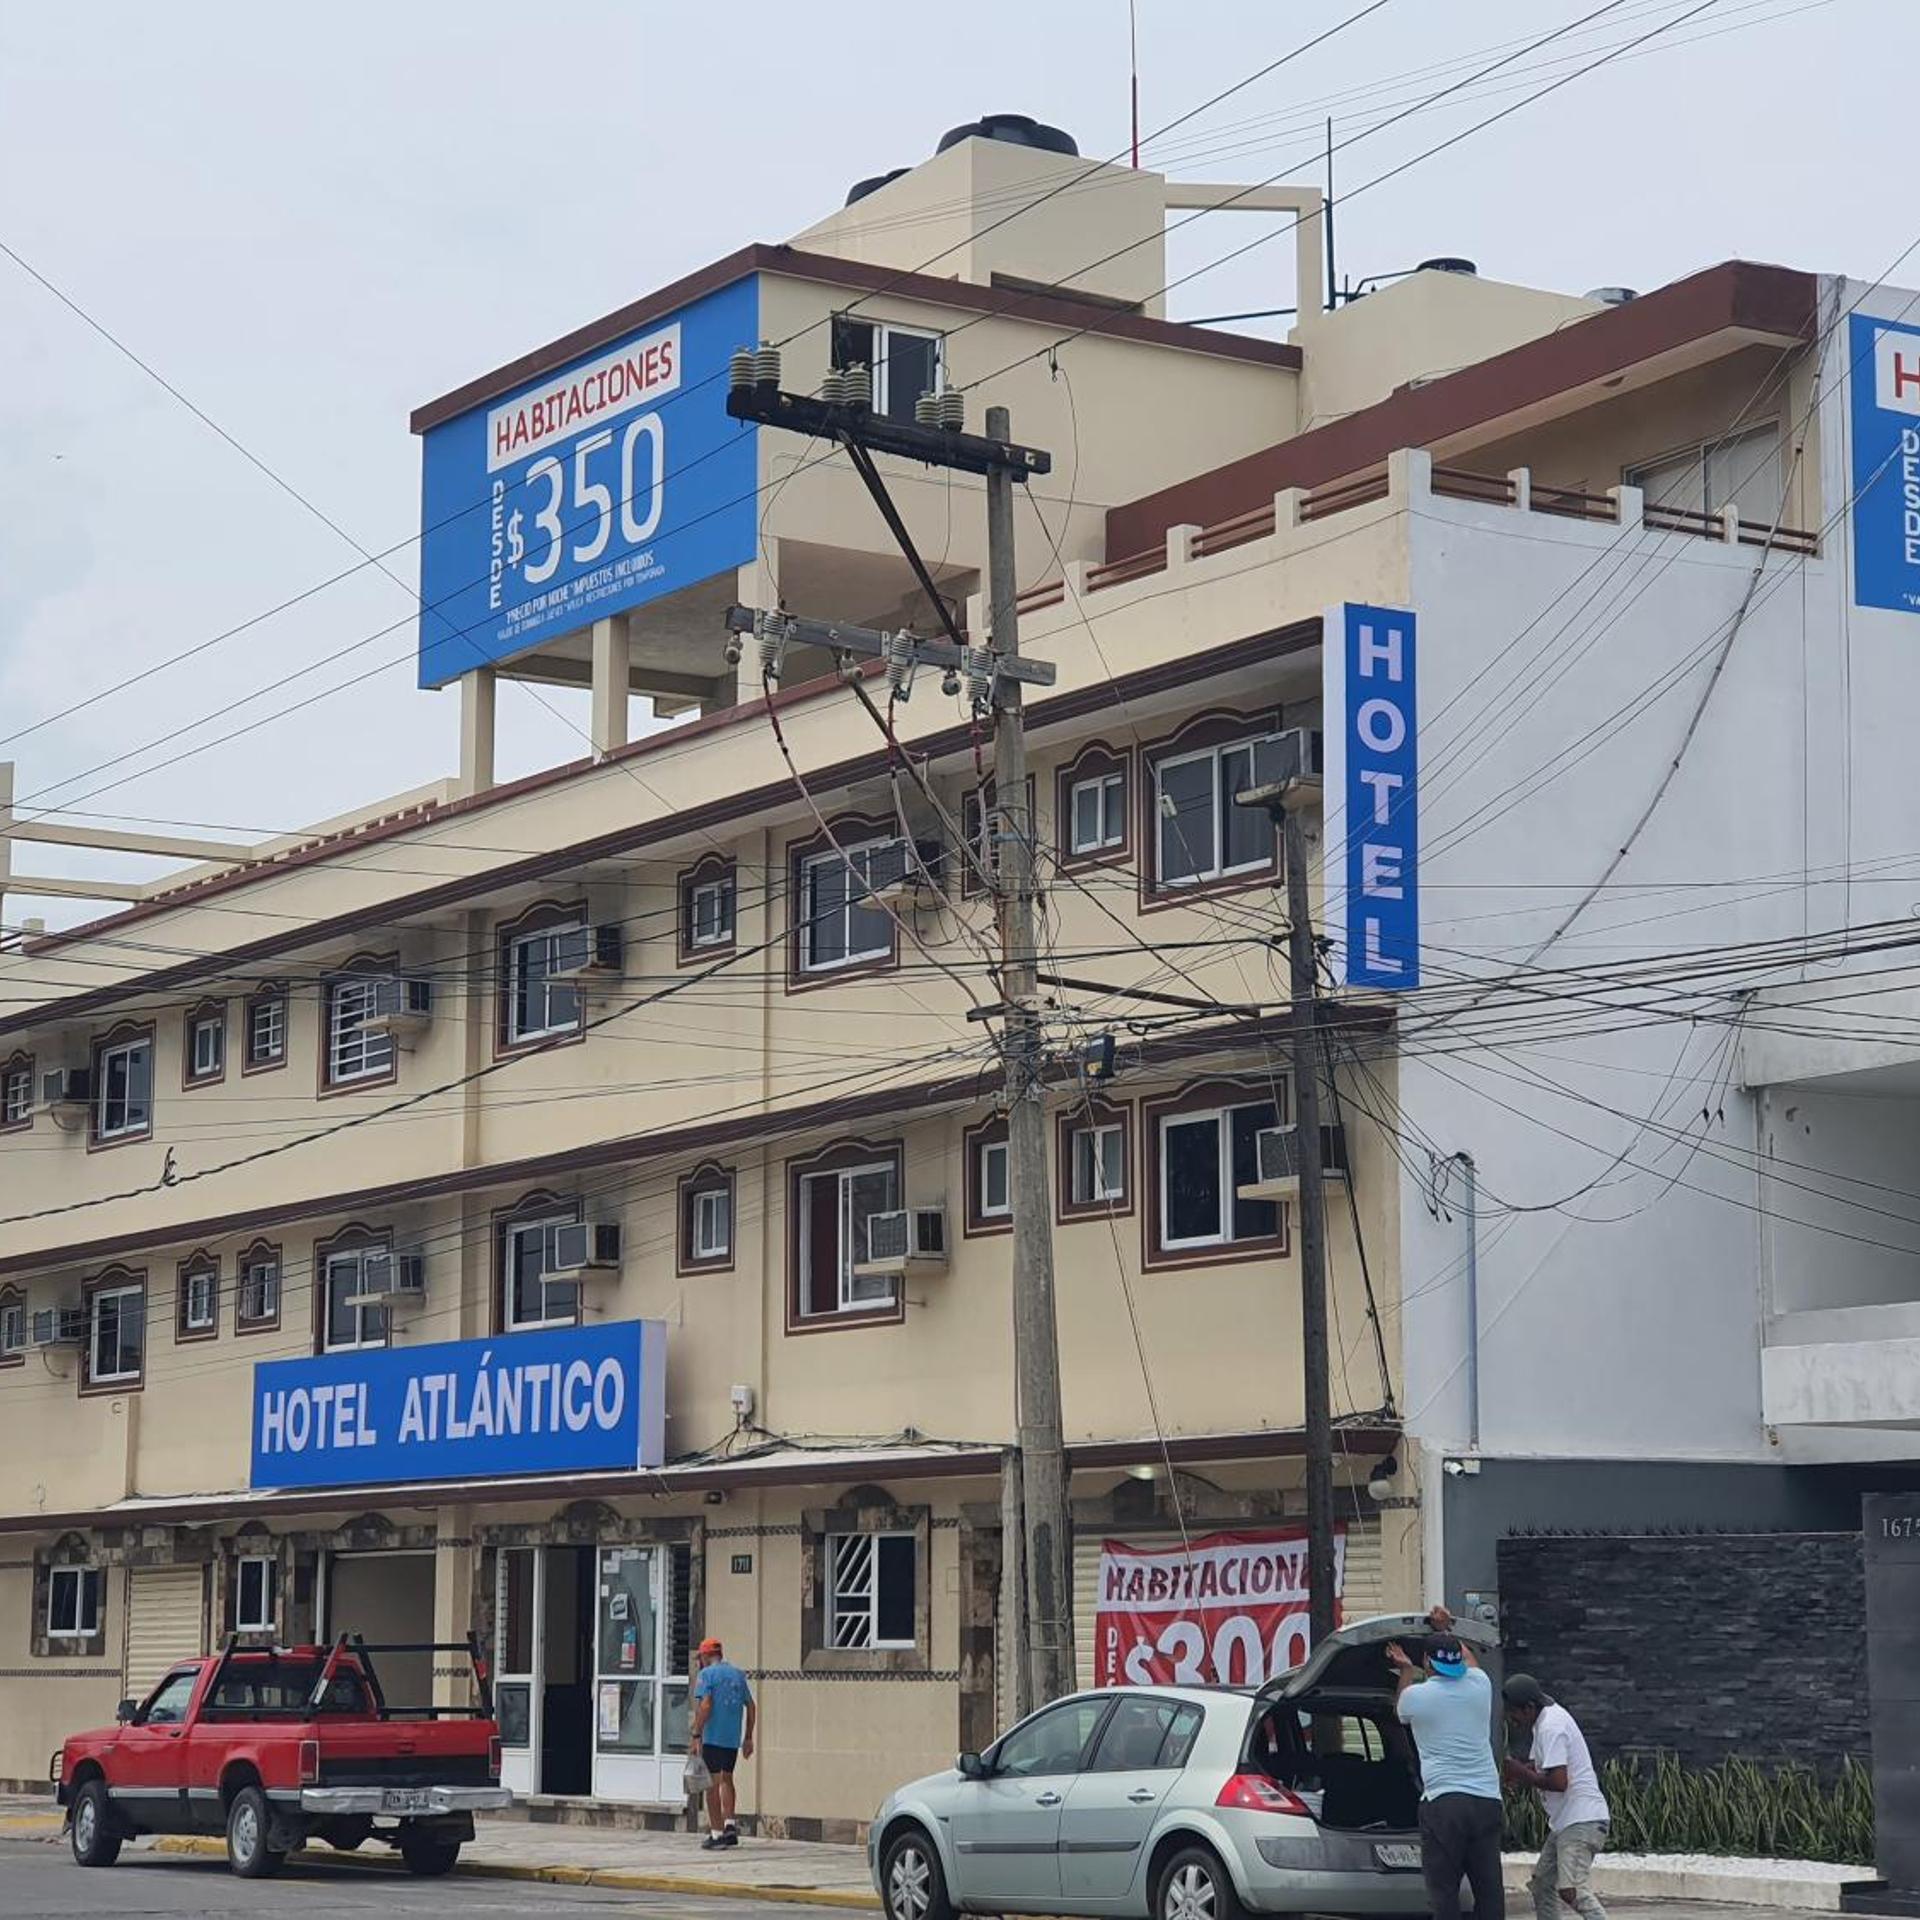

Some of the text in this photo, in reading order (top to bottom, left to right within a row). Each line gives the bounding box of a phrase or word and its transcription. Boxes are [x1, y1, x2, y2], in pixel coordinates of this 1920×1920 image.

[495, 340, 673, 457] HABITACIONES
[490, 479, 504, 609] DESDE
[507, 411, 664, 585] $350
[1903, 429, 1920, 564] DESDE
[1355, 625, 1406, 974] HOTEL
[262, 1351, 624, 1454] HOTEL ATLÁNTICO
